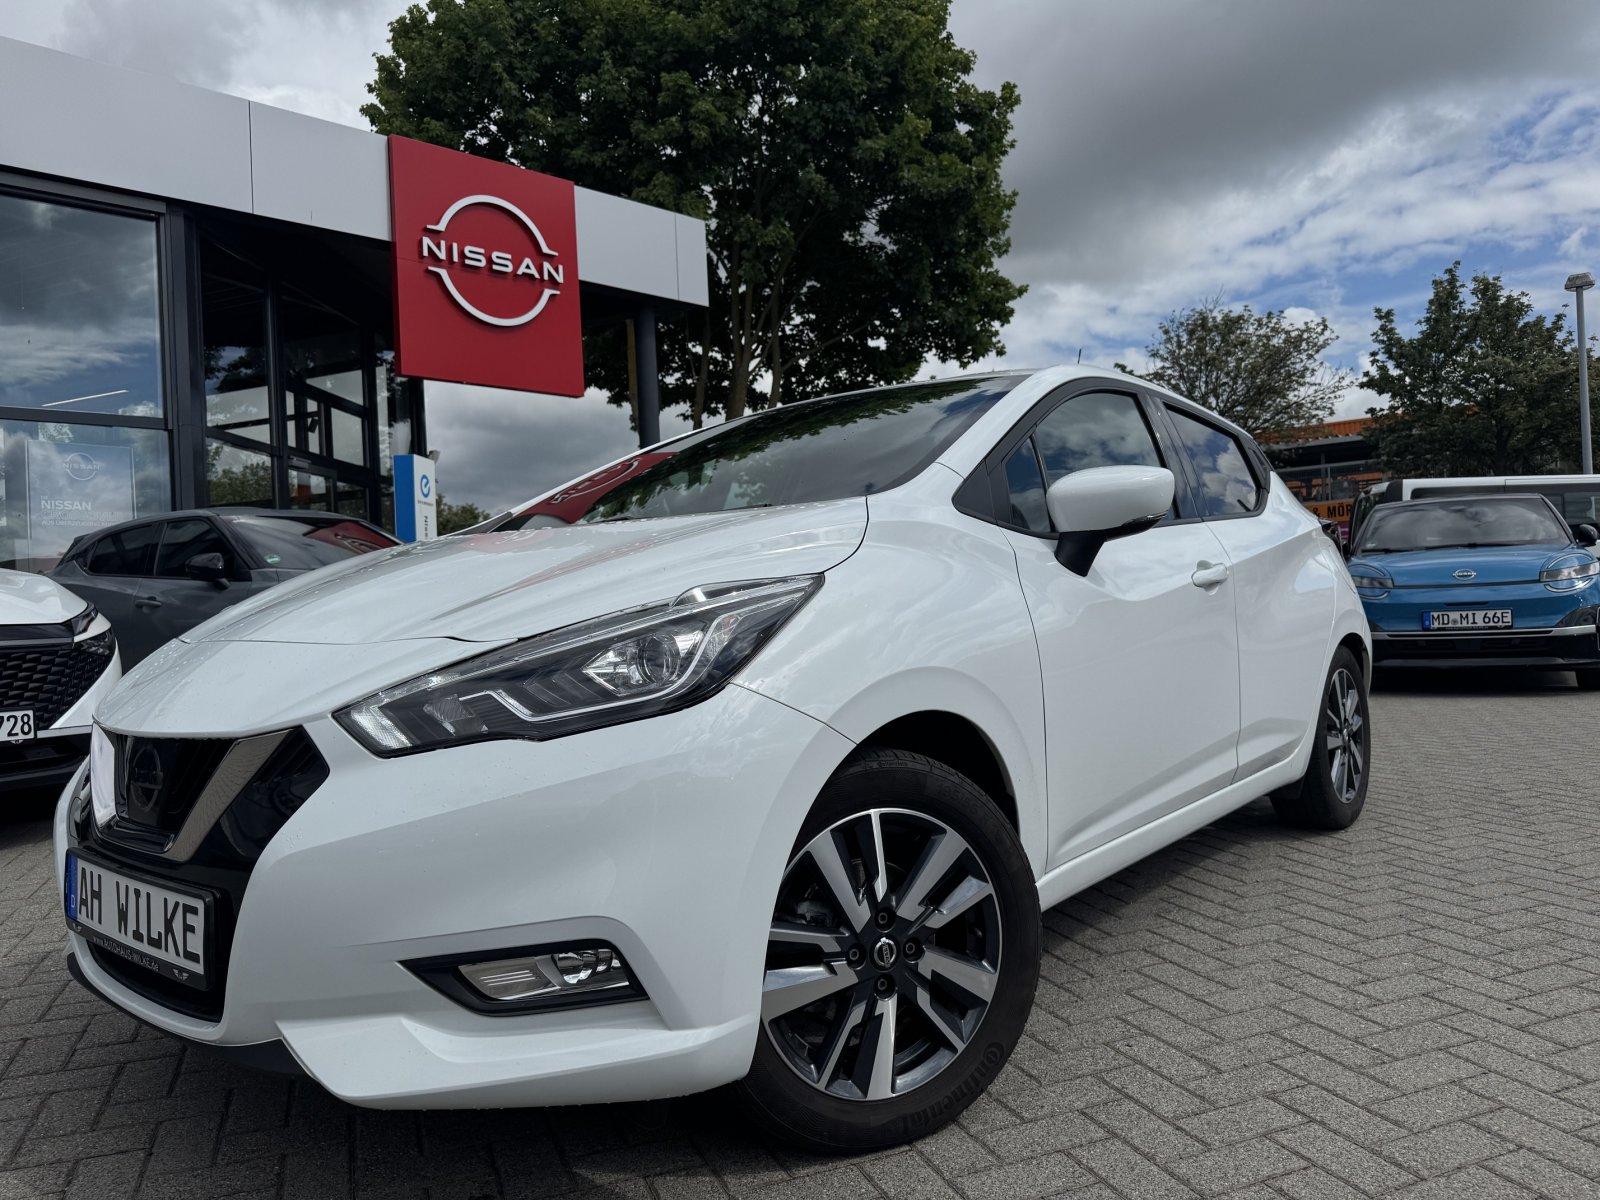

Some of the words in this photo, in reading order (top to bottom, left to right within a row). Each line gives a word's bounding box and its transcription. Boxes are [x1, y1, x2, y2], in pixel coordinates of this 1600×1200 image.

[422, 236, 564, 284] NISSAN
[41, 500, 92, 511] NISSAN
[1431, 613, 1450, 626] MD
[1459, 612, 1478, 625] MI
[1482, 611, 1511, 624] 66E
[79, 866, 102, 925] AH
[116, 880, 201, 965] WILKE
